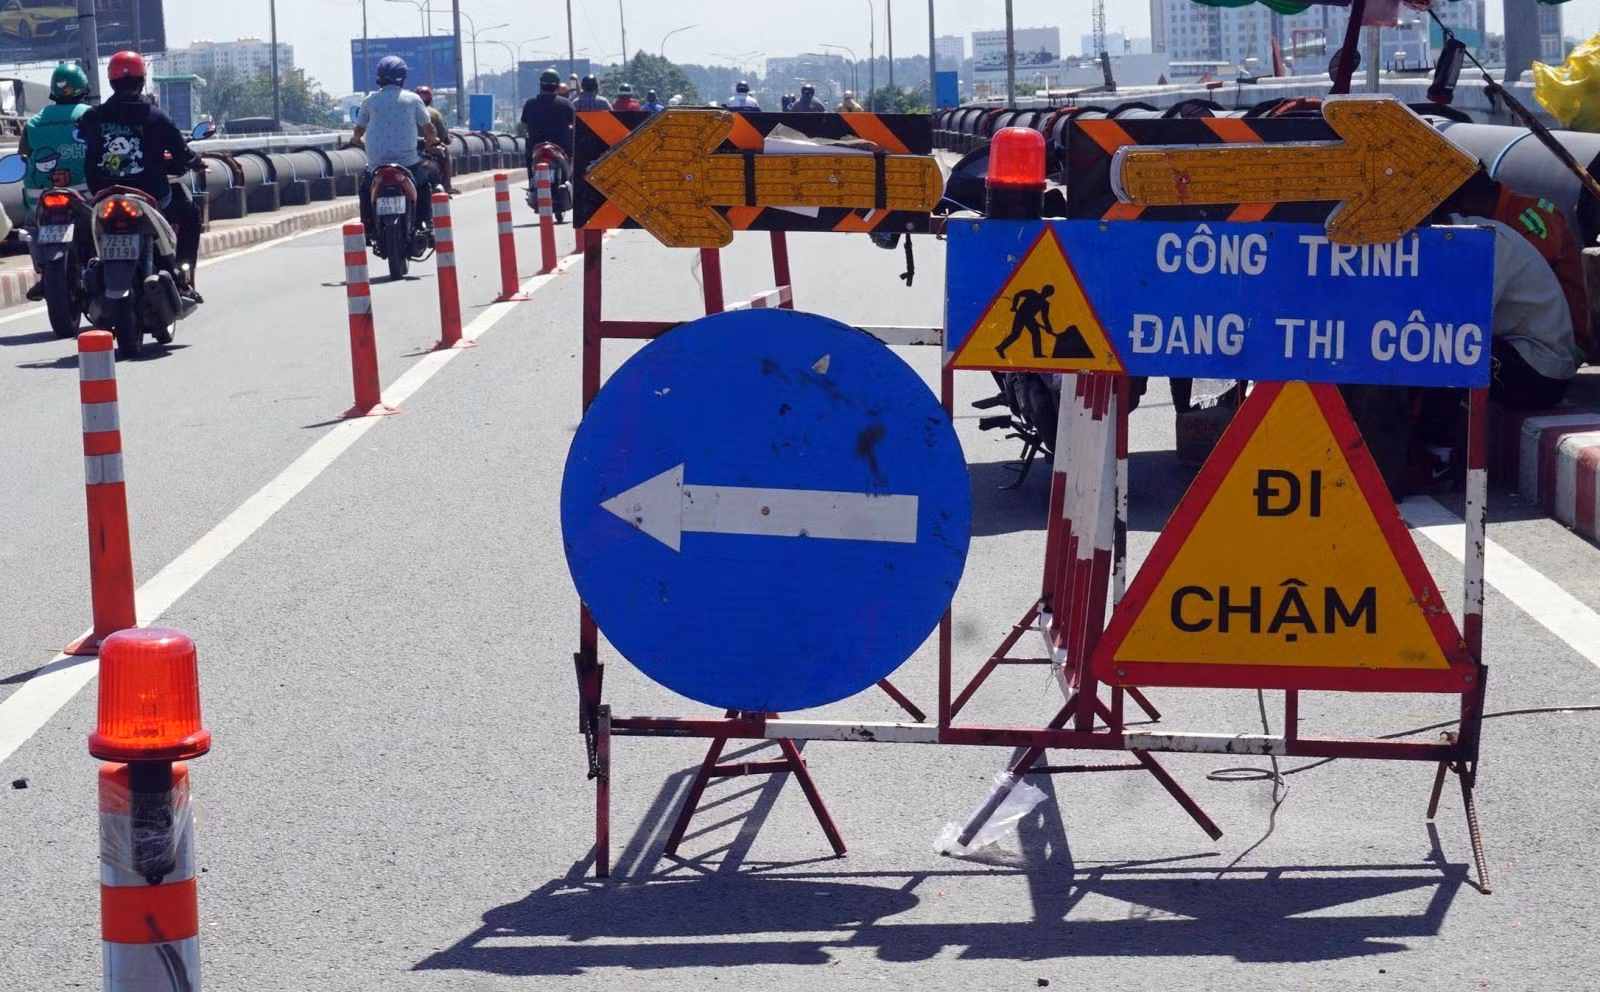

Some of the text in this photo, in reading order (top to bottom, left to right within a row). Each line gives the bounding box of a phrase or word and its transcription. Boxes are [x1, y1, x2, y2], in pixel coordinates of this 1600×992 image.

[57, 143, 88, 159] GH
[1156, 223, 1268, 275] CÔNG
[1128, 309, 1483, 366] ĐANG THI CÔNG
[1252, 469, 1322, 517] ĐI
[1170, 578, 1377, 642] CHẬM
